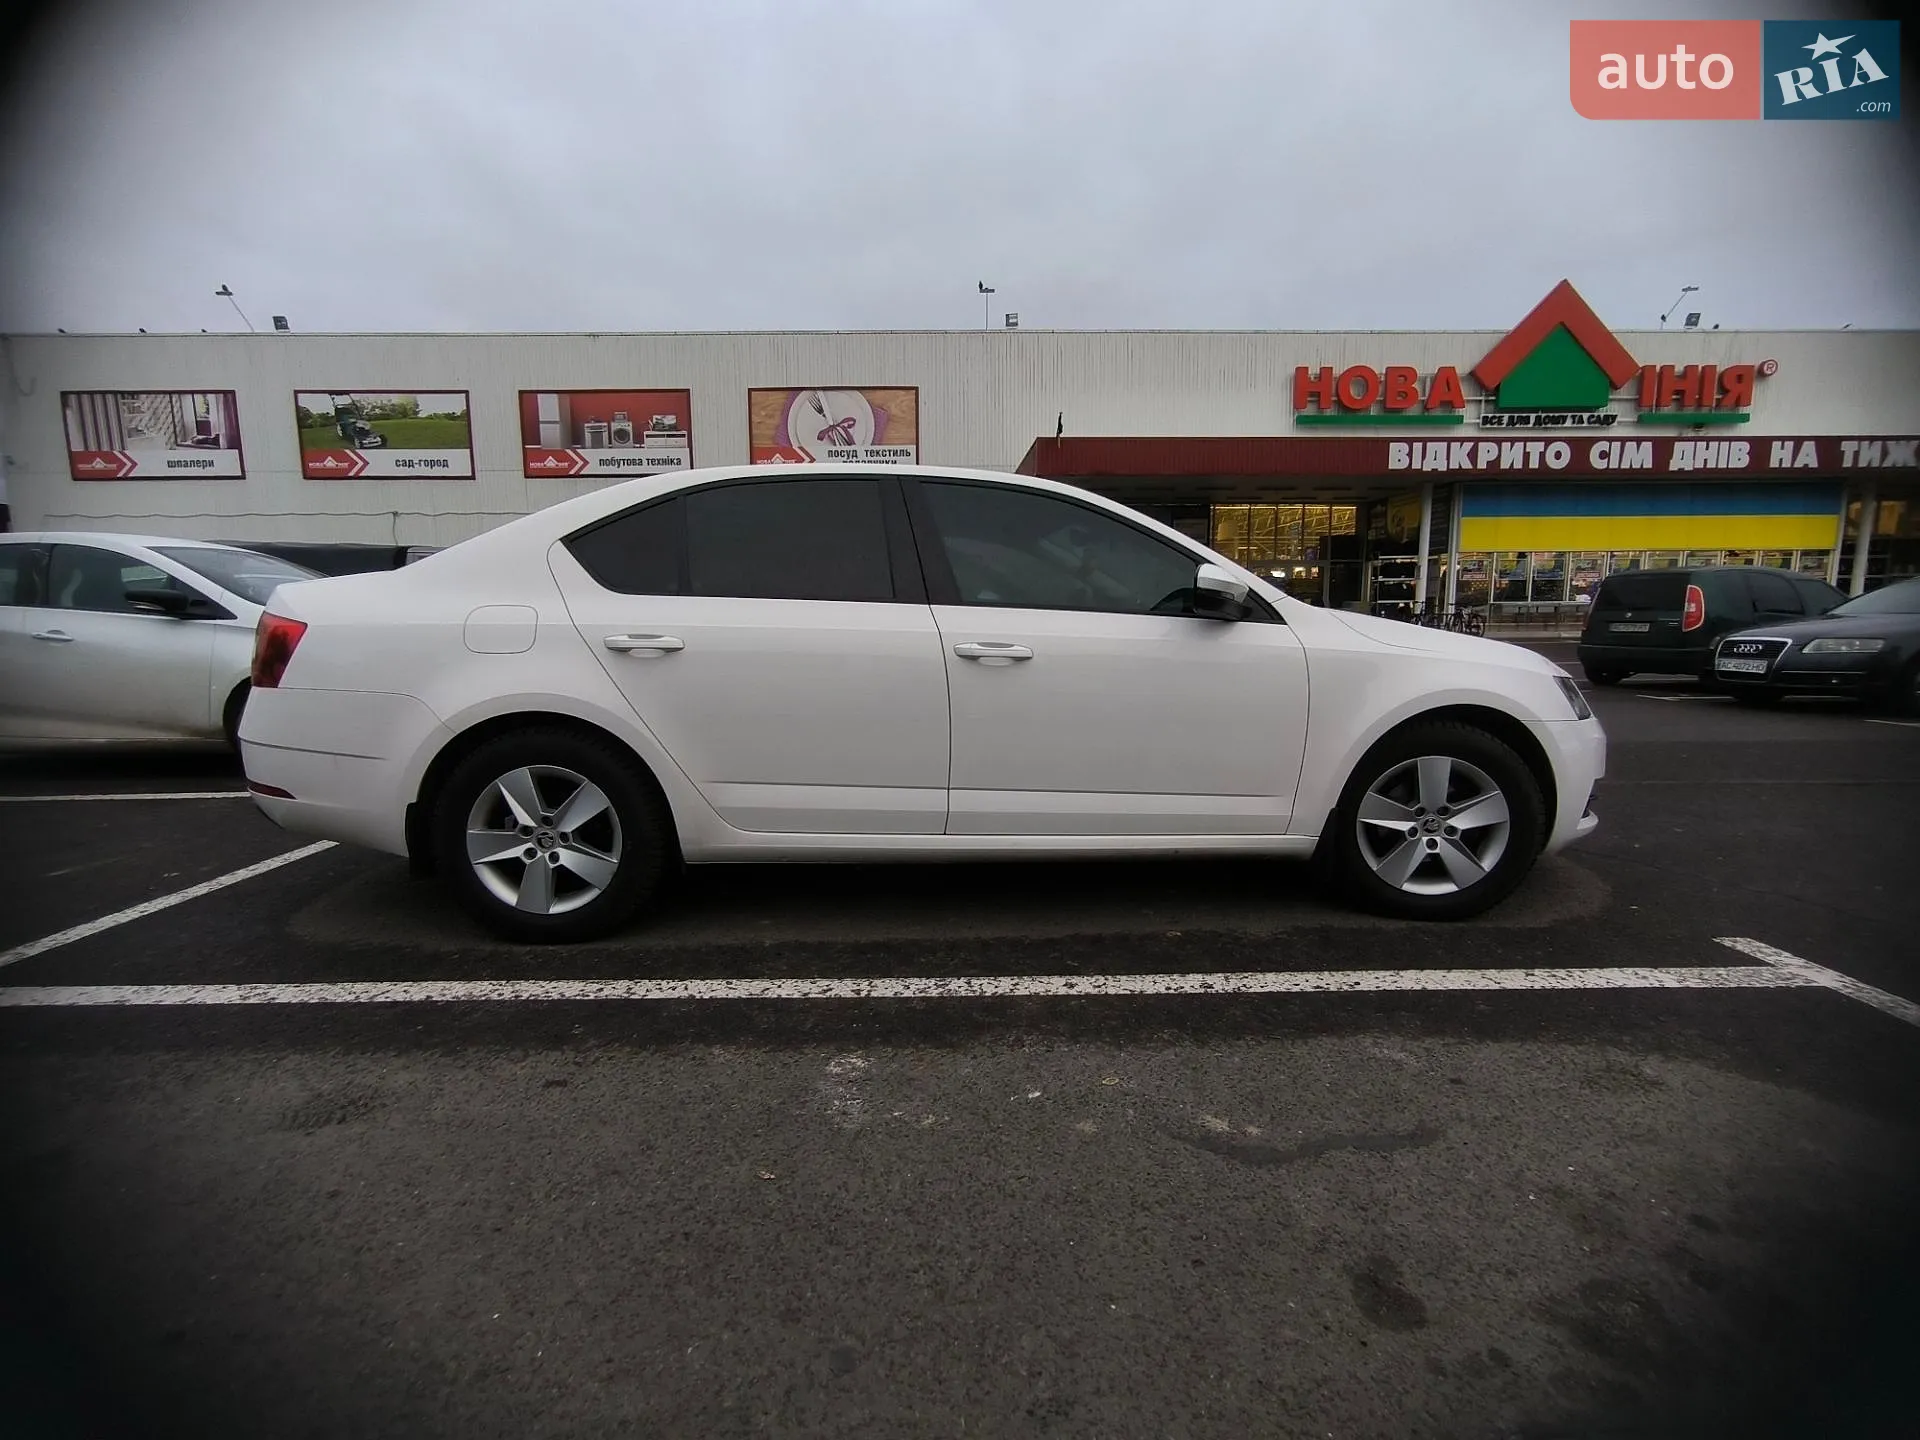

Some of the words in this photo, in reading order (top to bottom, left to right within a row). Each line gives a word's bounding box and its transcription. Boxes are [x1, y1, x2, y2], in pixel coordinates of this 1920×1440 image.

[1293, 365, 1465, 411] НОВА
[1481, 415, 1505, 426] ВСЕ
[1570, 414, 1585, 426] ТА
[1587, 414, 1618, 426] САДУ
[828, 449, 858, 460] посуд
[864, 448, 911, 458] текстиль
[1388, 441, 1571, 471] ВІДКРИТО
[1589, 441, 1653, 469] СІМ
[1668, 441, 1751, 471] ДНІВ
[1769, 440, 1819, 468] НА
[167, 459, 215, 470] шпалери
[395, 457, 449, 470] сад-город
[599, 456, 643, 469] побутова
[646, 456, 682, 467] техніка
